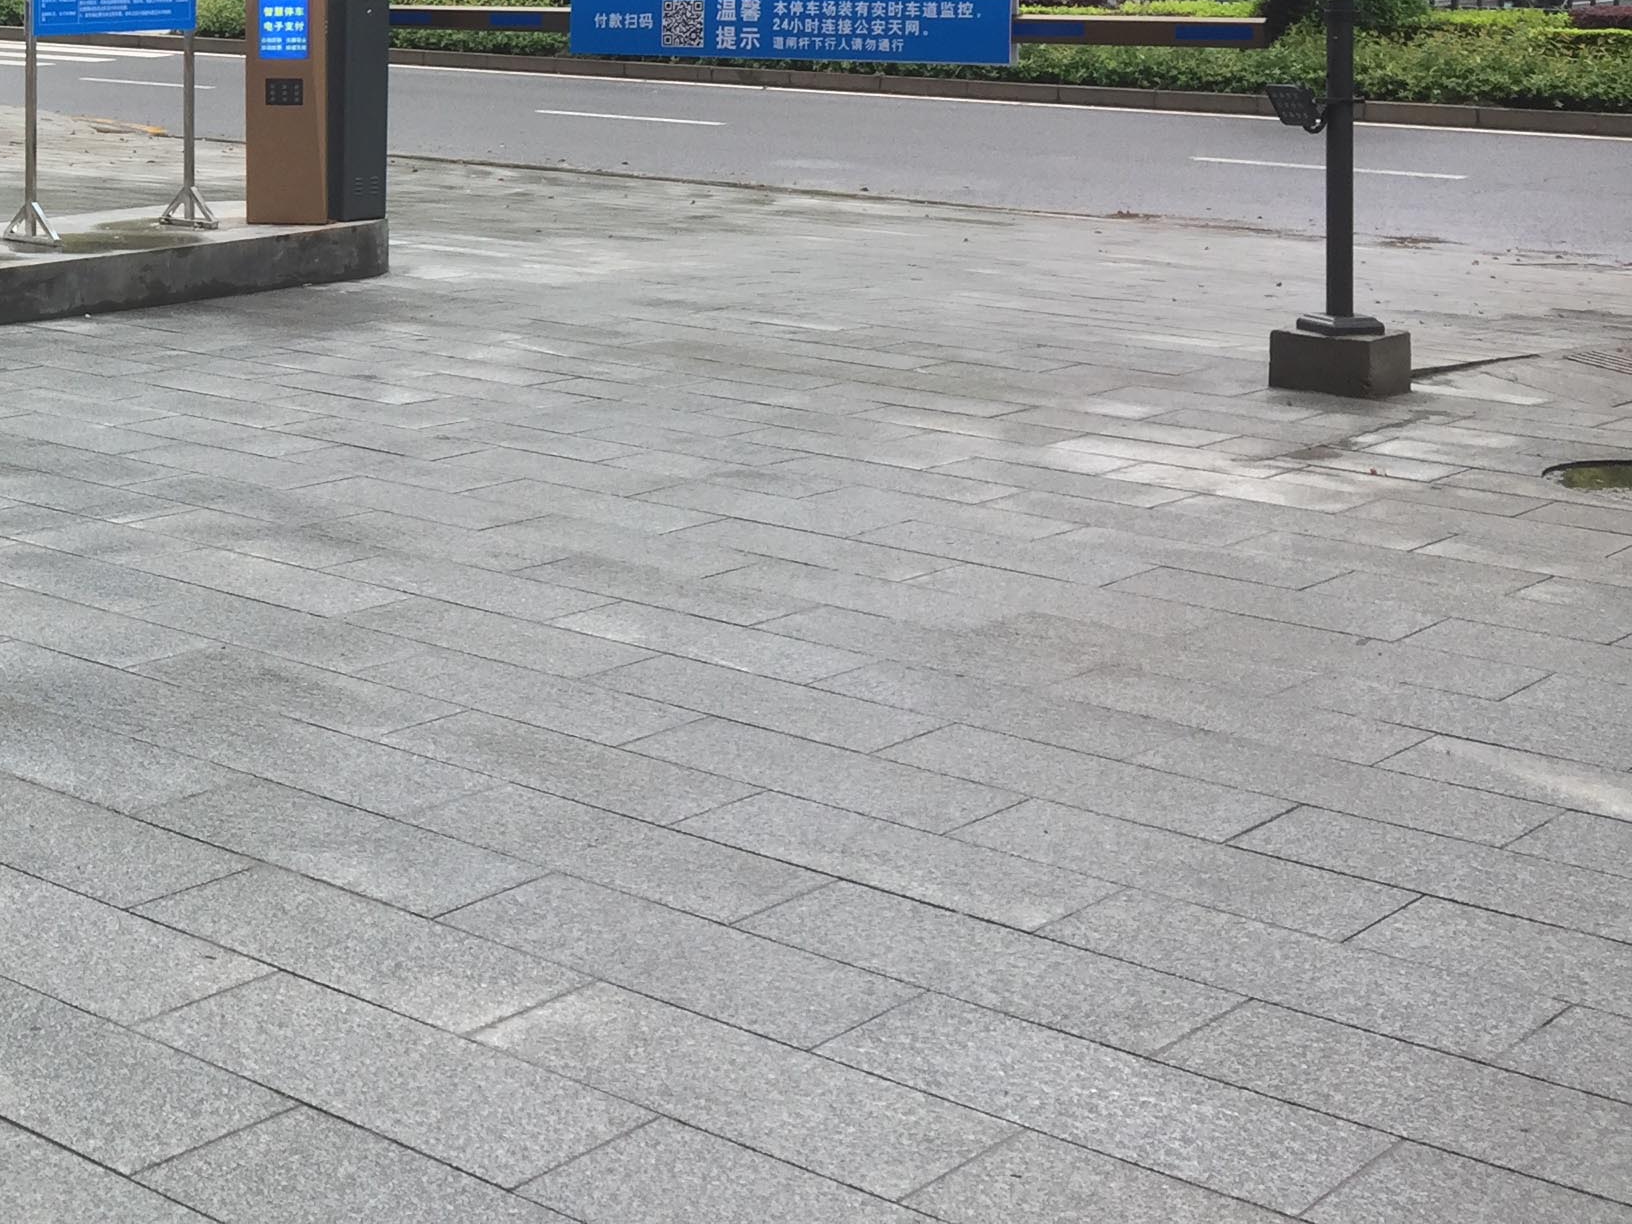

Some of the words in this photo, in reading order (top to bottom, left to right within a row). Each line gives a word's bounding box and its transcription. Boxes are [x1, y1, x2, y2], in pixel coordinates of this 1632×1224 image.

[263, 6, 304, 17] 智慧停车
[263, 21, 304, 32] 电子支付
[594, 13, 653, 29] 付款扫码
[717, 27, 761, 50] 提示
